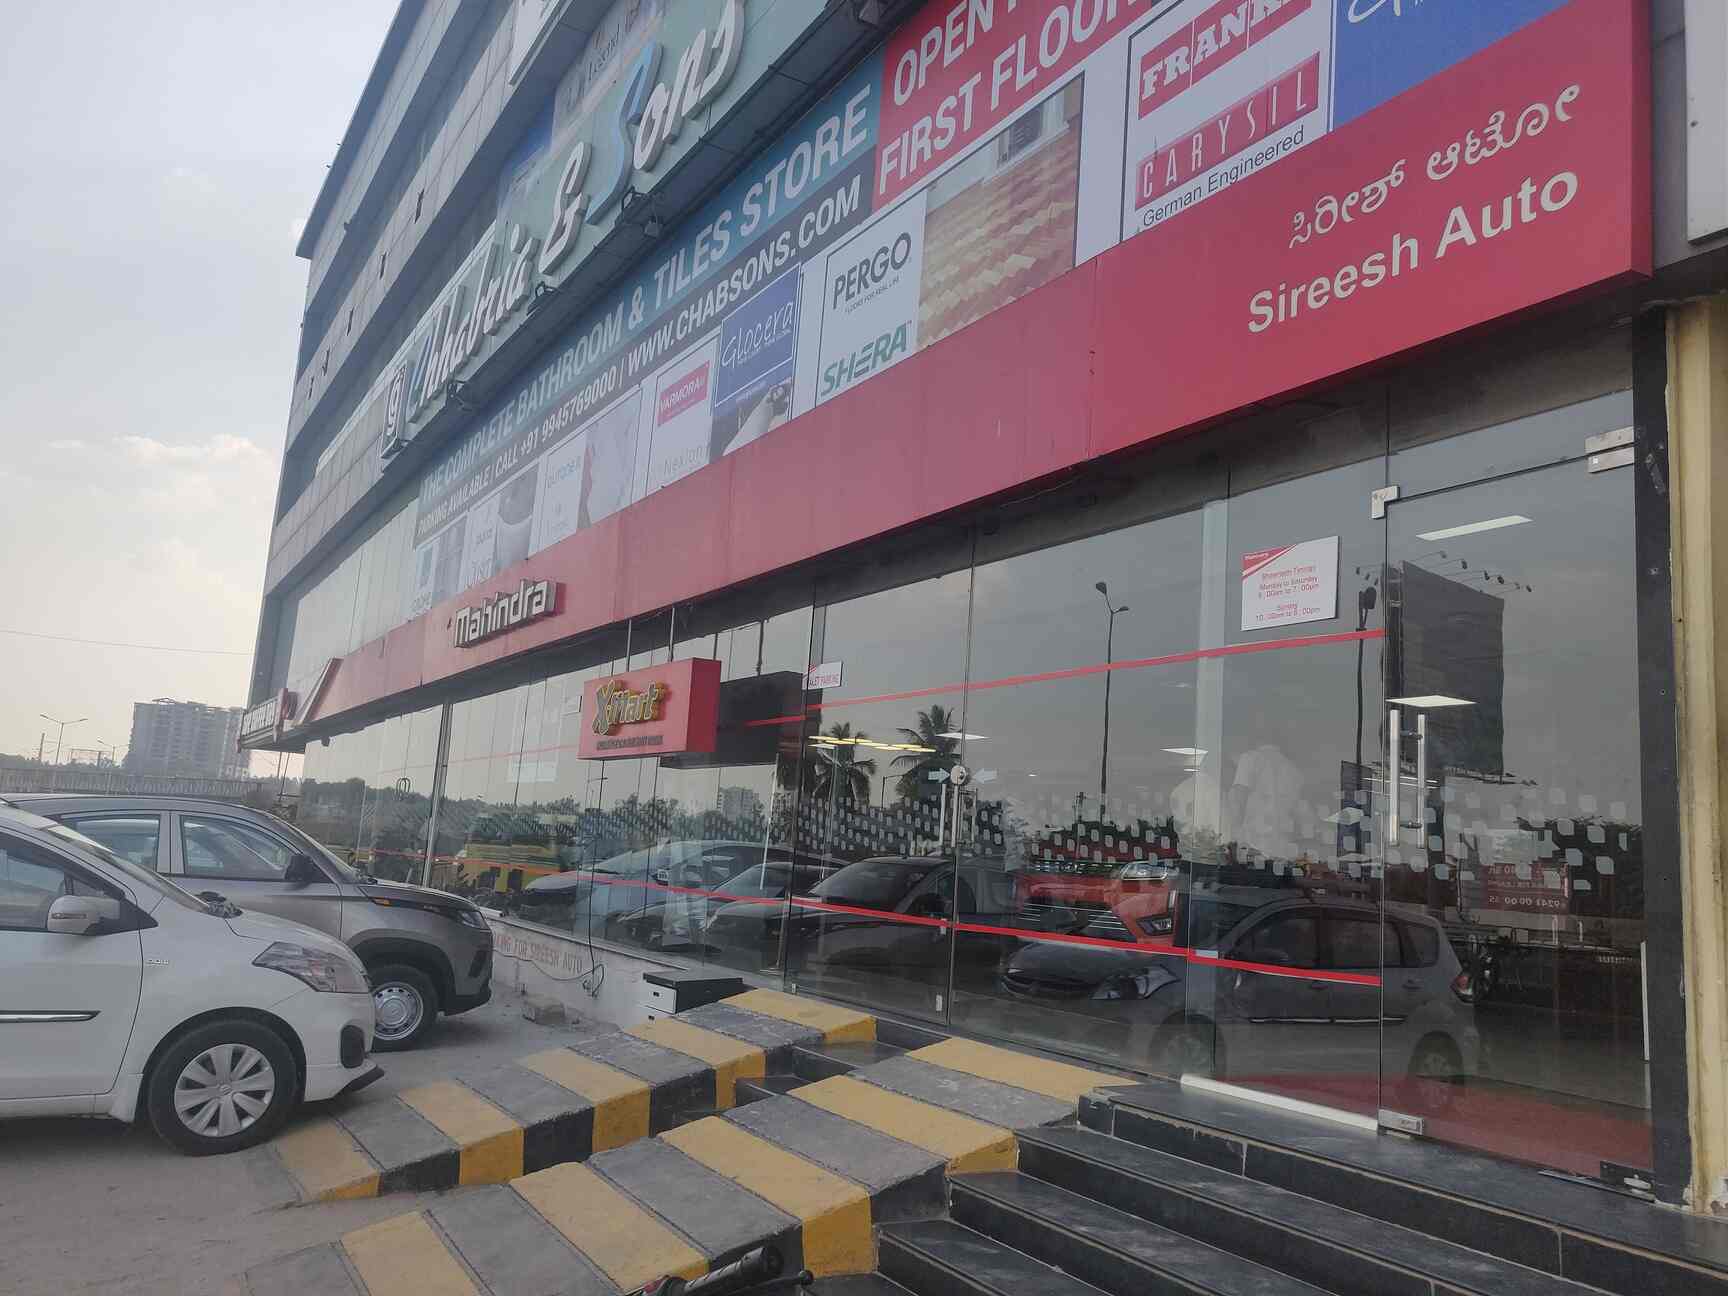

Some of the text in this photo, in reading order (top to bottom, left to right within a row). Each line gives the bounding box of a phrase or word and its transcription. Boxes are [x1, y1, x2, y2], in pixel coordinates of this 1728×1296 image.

[893, 0, 995, 106] OPEN
[1142, 0, 1292, 100] FRANK
[584, 0, 744, 226] Sons
[879, 72, 982, 195] FIRST
[1142, 71, 1307, 199] CARYSIL
[1425, 84, 1580, 182] ಆಟೋ
[1142, 124, 1305, 228] German Engineered
[445, 399, 514, 483] COMPLETE
[515, 310, 624, 425] BATHROOM
[627, 286, 645, 329] &
[653, 209, 732, 310] TILES
[739, 83, 872, 238] STORE
[833, 231, 912, 310] PERGO
[1247, 170, 1579, 334] Sireesh Auto
[494, 445, 519, 478] CALL
[627, 174, 861, 377] WWW.CHABSONS.COM
[820, 323, 908, 397] SHERA
[455, 579, 551, 647] Mahindra
